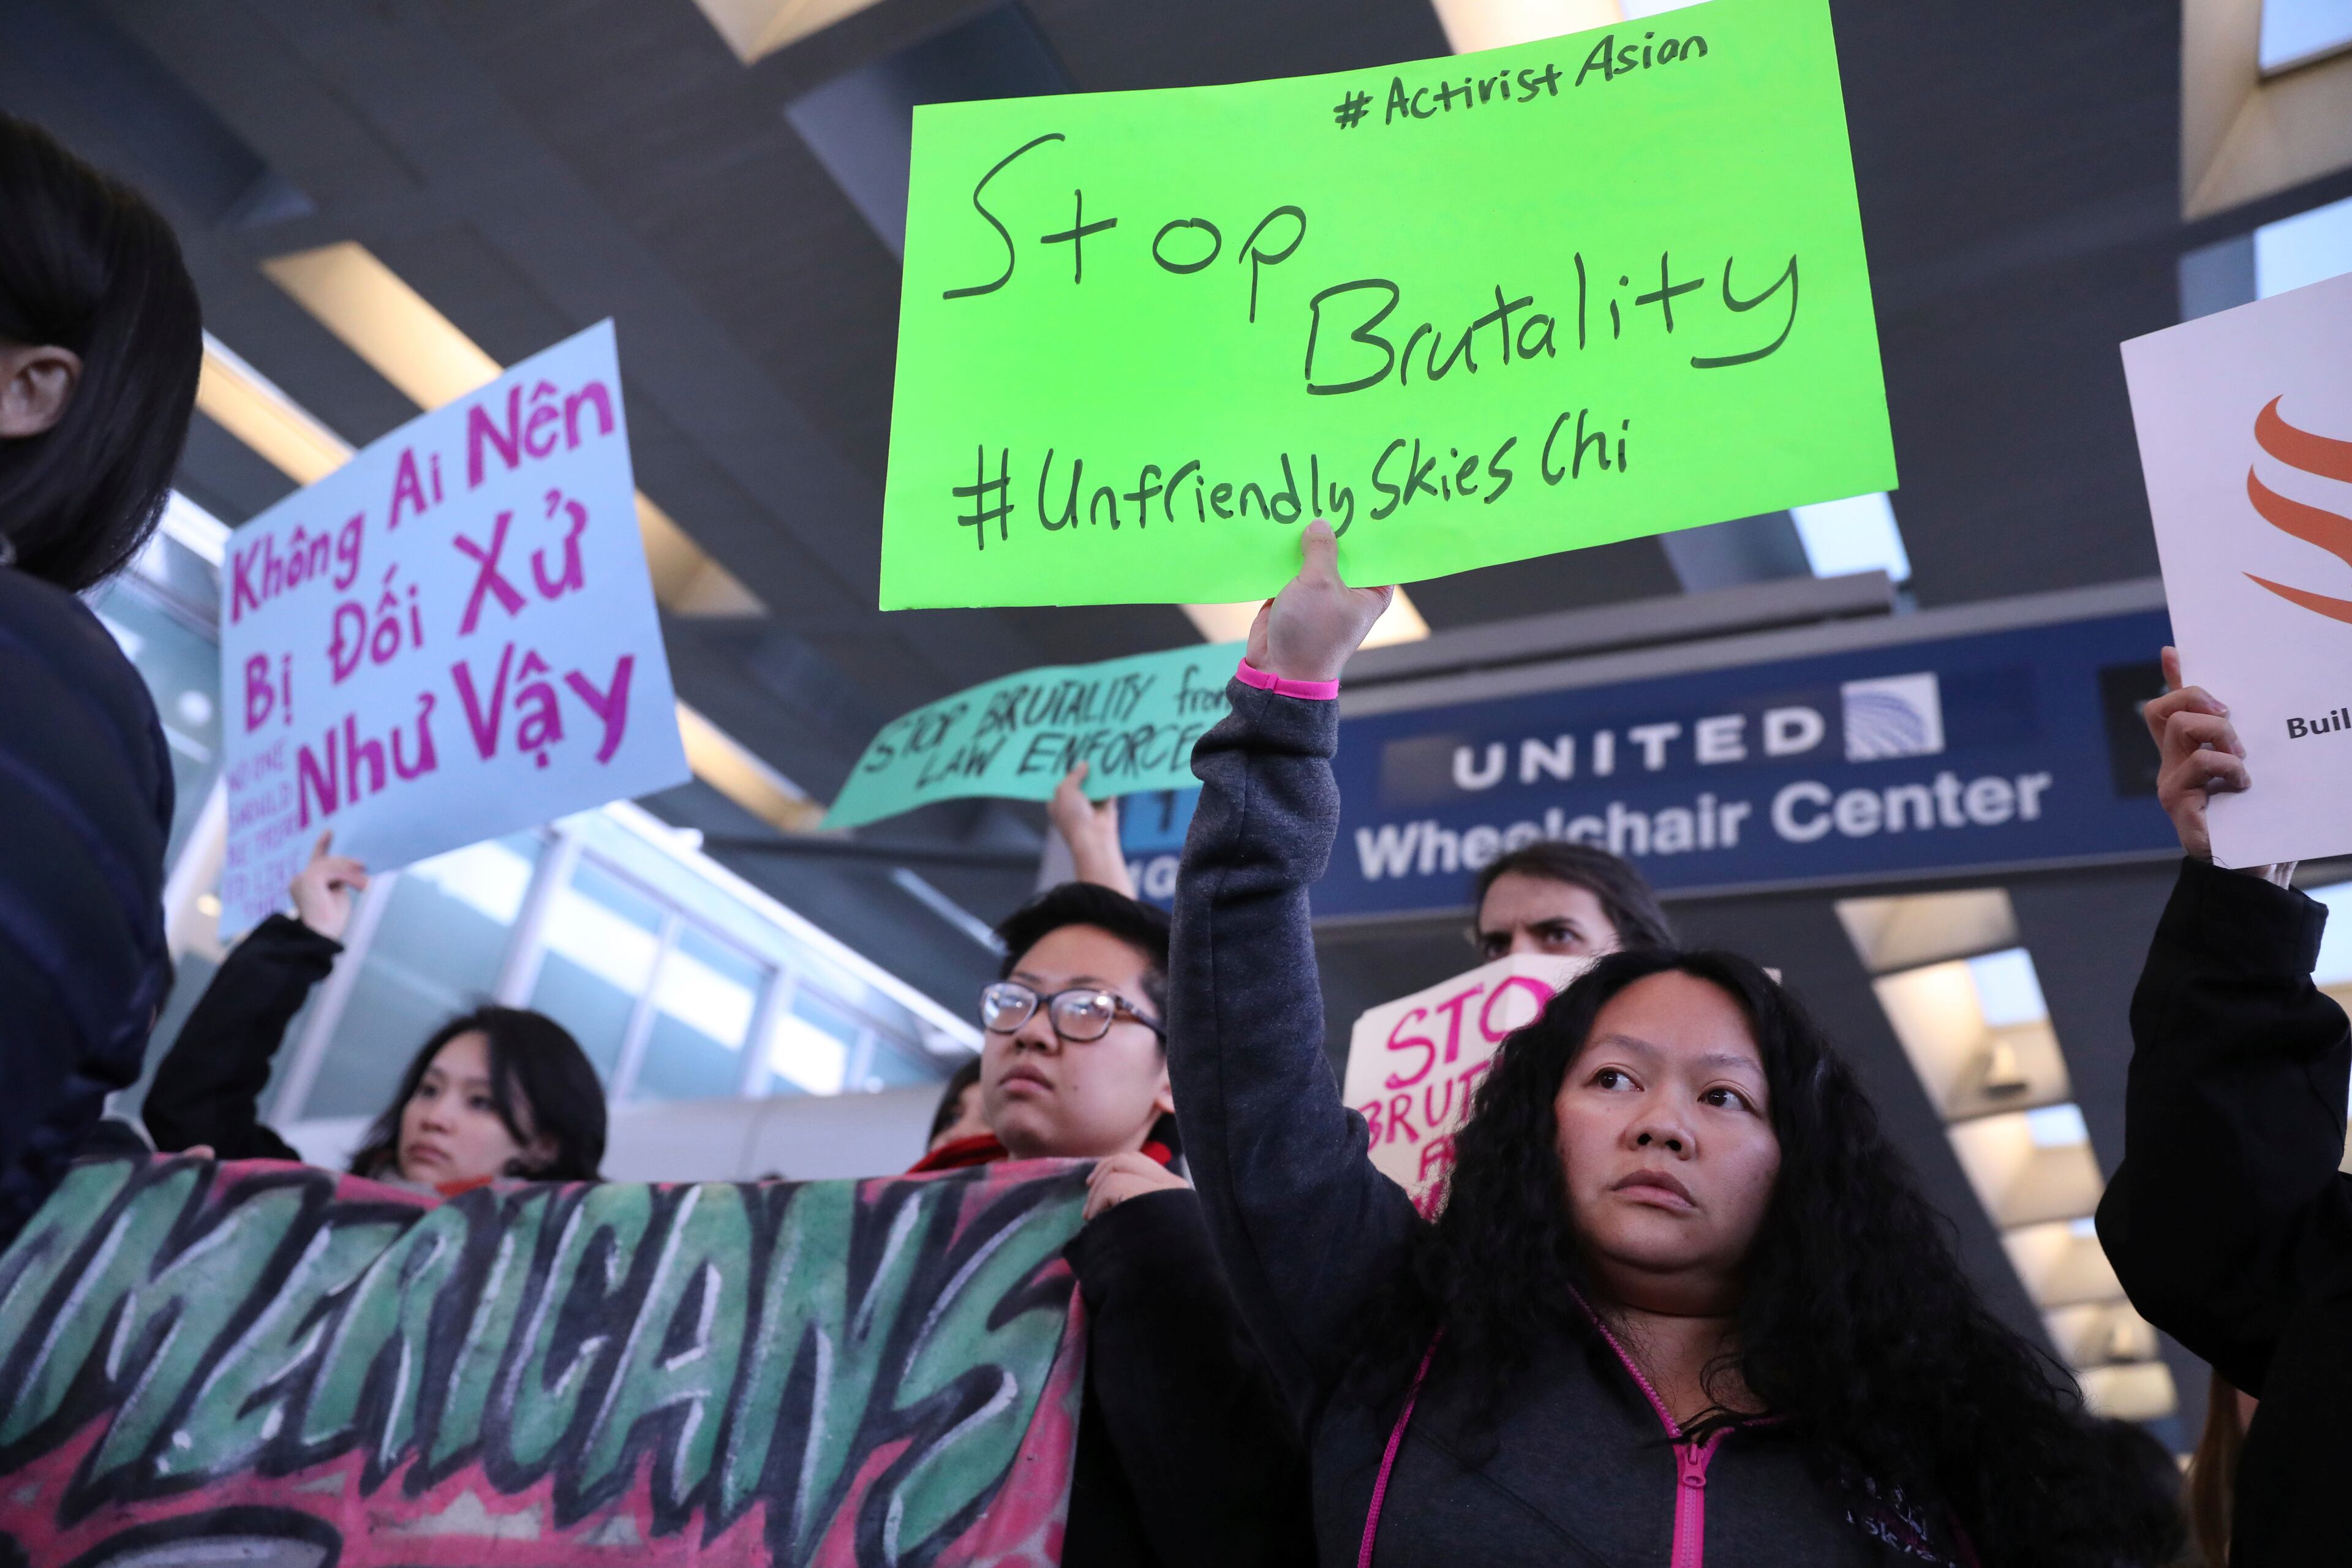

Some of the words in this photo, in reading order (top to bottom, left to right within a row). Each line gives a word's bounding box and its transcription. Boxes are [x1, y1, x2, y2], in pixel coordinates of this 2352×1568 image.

[942, 132, 1307, 323] Stop
[1304, 251, 1799, 396] Brutality
[230, 512, 365, 625] Không
[388, 447, 445, 529] Ai
[467, 379, 615, 489] Nên
[244, 652, 293, 734] Bị
[327, 562, 424, 686] Đối
[452, 488, 589, 637] Xử
[450, 642, 636, 771] Vậy
[864, 703, 968, 773] STOP
[976, 673, 1158, 736] BRUTALITY
[915, 739, 1005, 790] LAW
[1452, 707, 1825, 790] UNITED
[1771, 773, 2052, 842] Center
